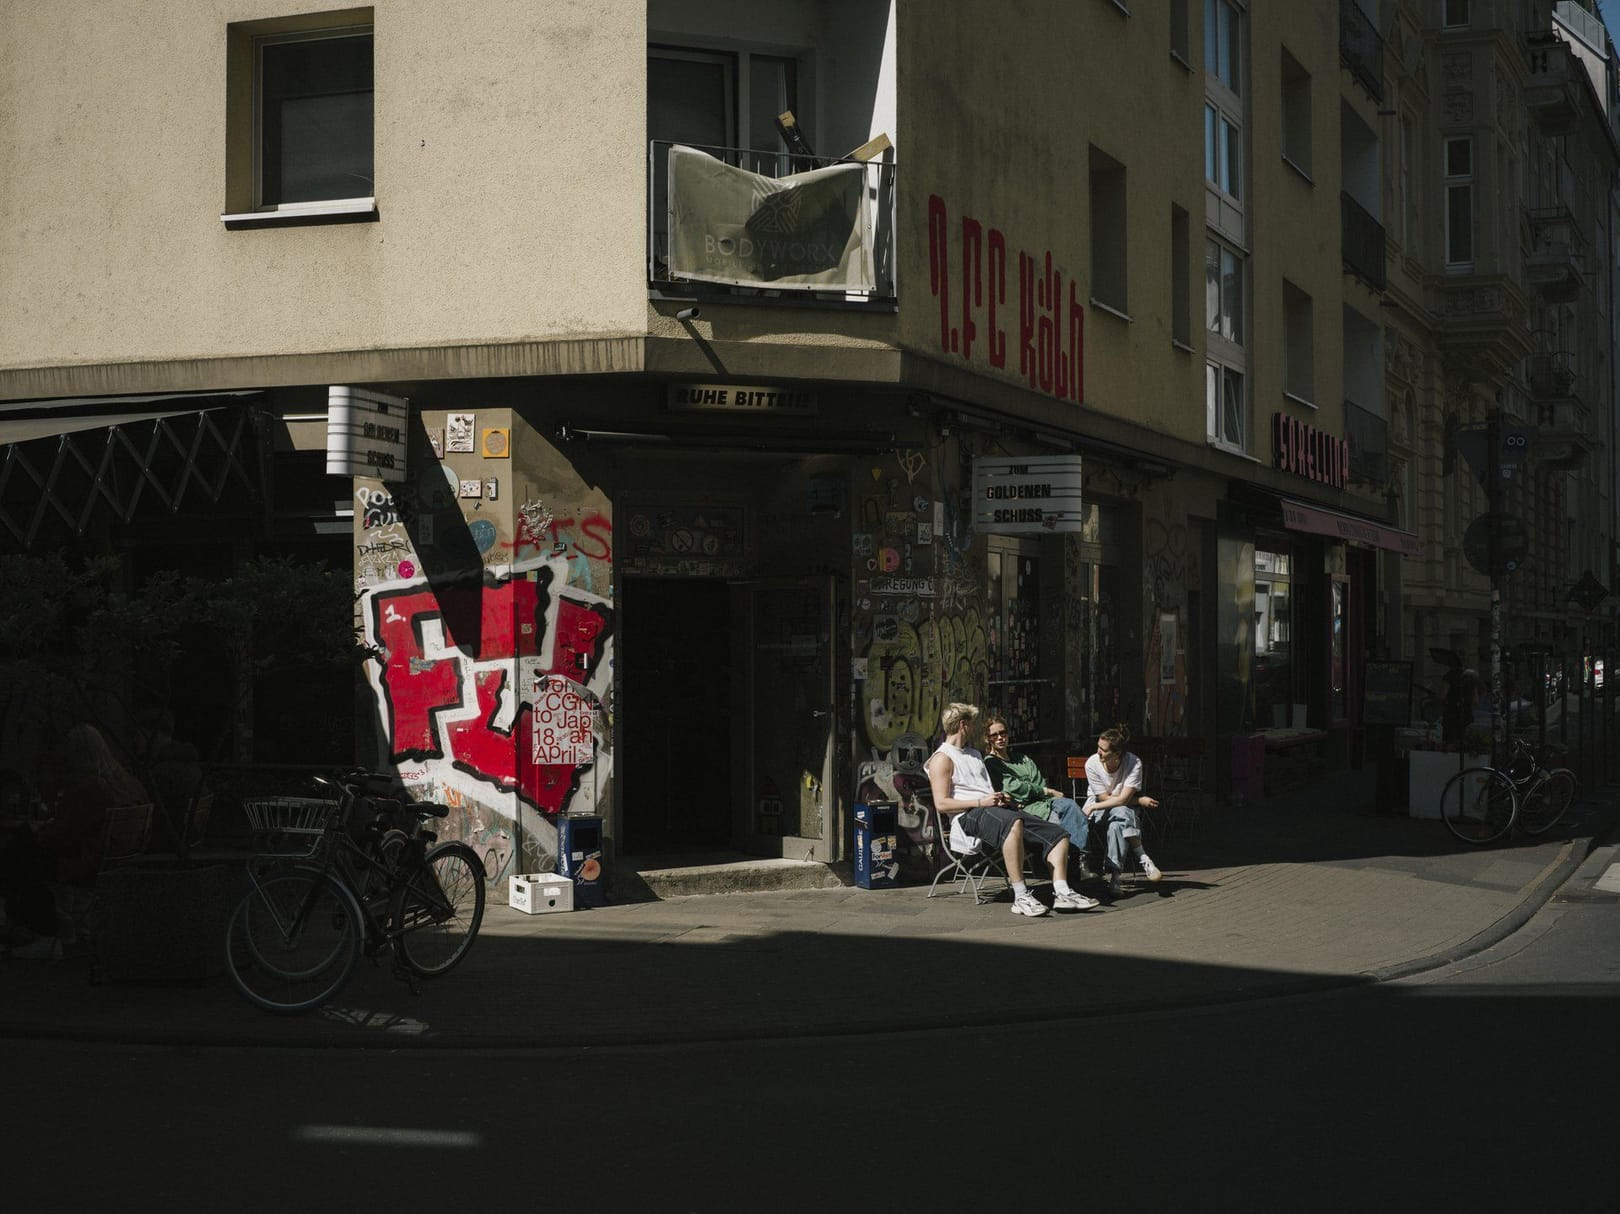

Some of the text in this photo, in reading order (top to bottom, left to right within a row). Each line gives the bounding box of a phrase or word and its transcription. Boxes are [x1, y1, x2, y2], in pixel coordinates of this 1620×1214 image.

[986, 484, 1051, 499] GOLDENEN
[994, 508, 1043, 522] SCHUSS
[534, 707, 591, 732] to Jap
[534, 728, 559, 745] 18.
[534, 746, 577, 763] April
